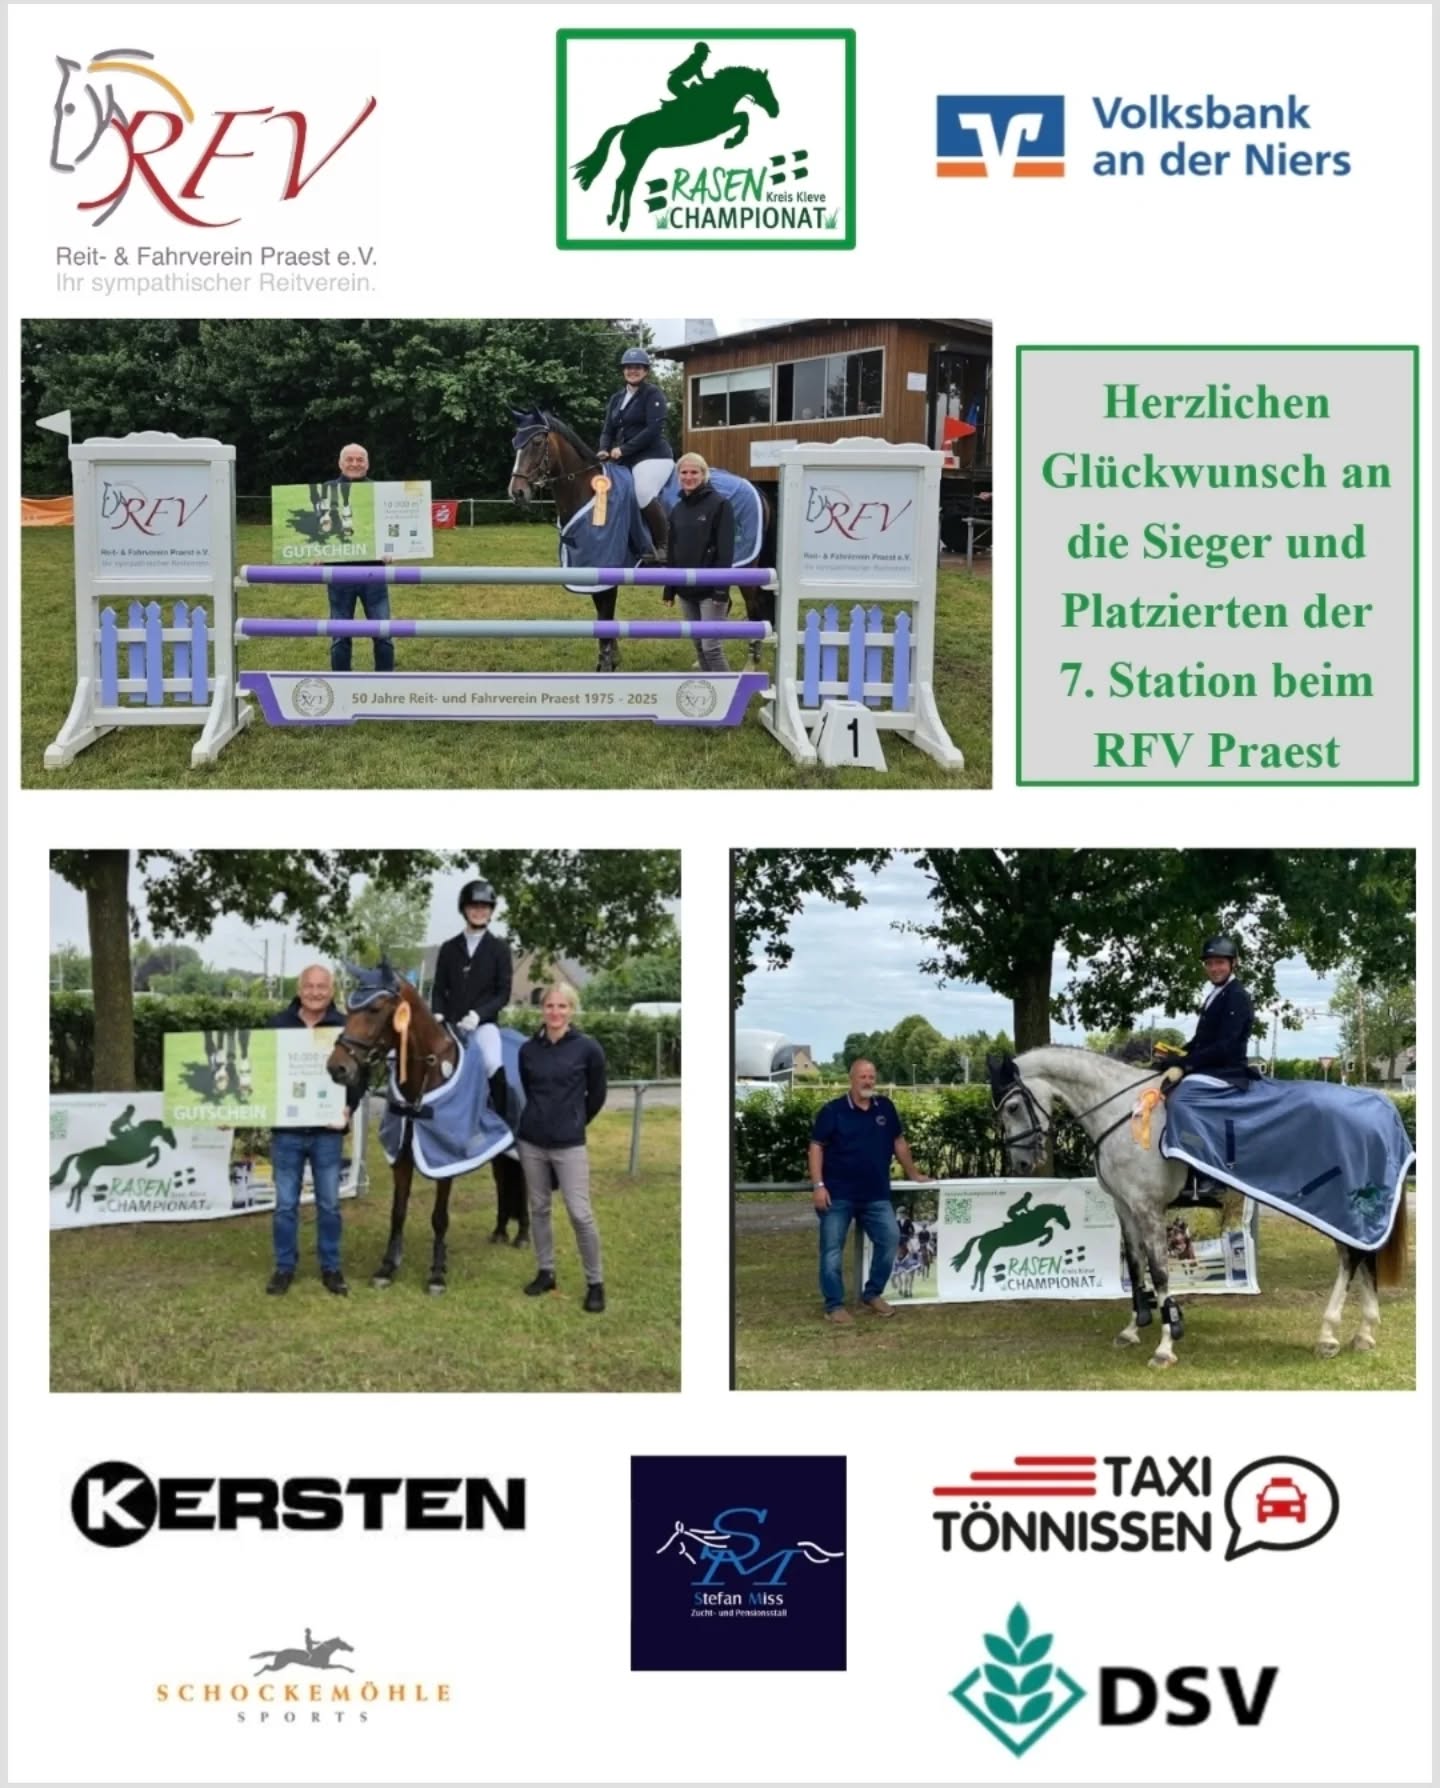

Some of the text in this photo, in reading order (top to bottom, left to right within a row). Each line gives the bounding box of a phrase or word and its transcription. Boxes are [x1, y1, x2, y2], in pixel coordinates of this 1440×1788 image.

[111, 494, 208, 536] RFV
[814, 499, 912, 541] RFV
[282, 544, 367, 559] GUTSCHEIN
[352, 693, 367, 704] 50
[371, 692, 405, 705] Jahre
[409, 692, 438, 704] Reit-
[442, 692, 467, 704] und
[471, 692, 537, 704] Fahrverein
[541, 692, 580, 705] Praest
[585, 693, 614, 705] 1975
[627, 693, 658, 705] 2025
[847, 717, 859, 758] 1
[174, 1104, 267, 1121] GUTSCHEIN
[111, 1177, 172, 1198] RASEN
[106, 1199, 206, 1213] CHAMPIONAT
[1008, 1256, 1063, 1276] RASEN
[1008, 1276, 1096, 1291] CHAMPIONAT
